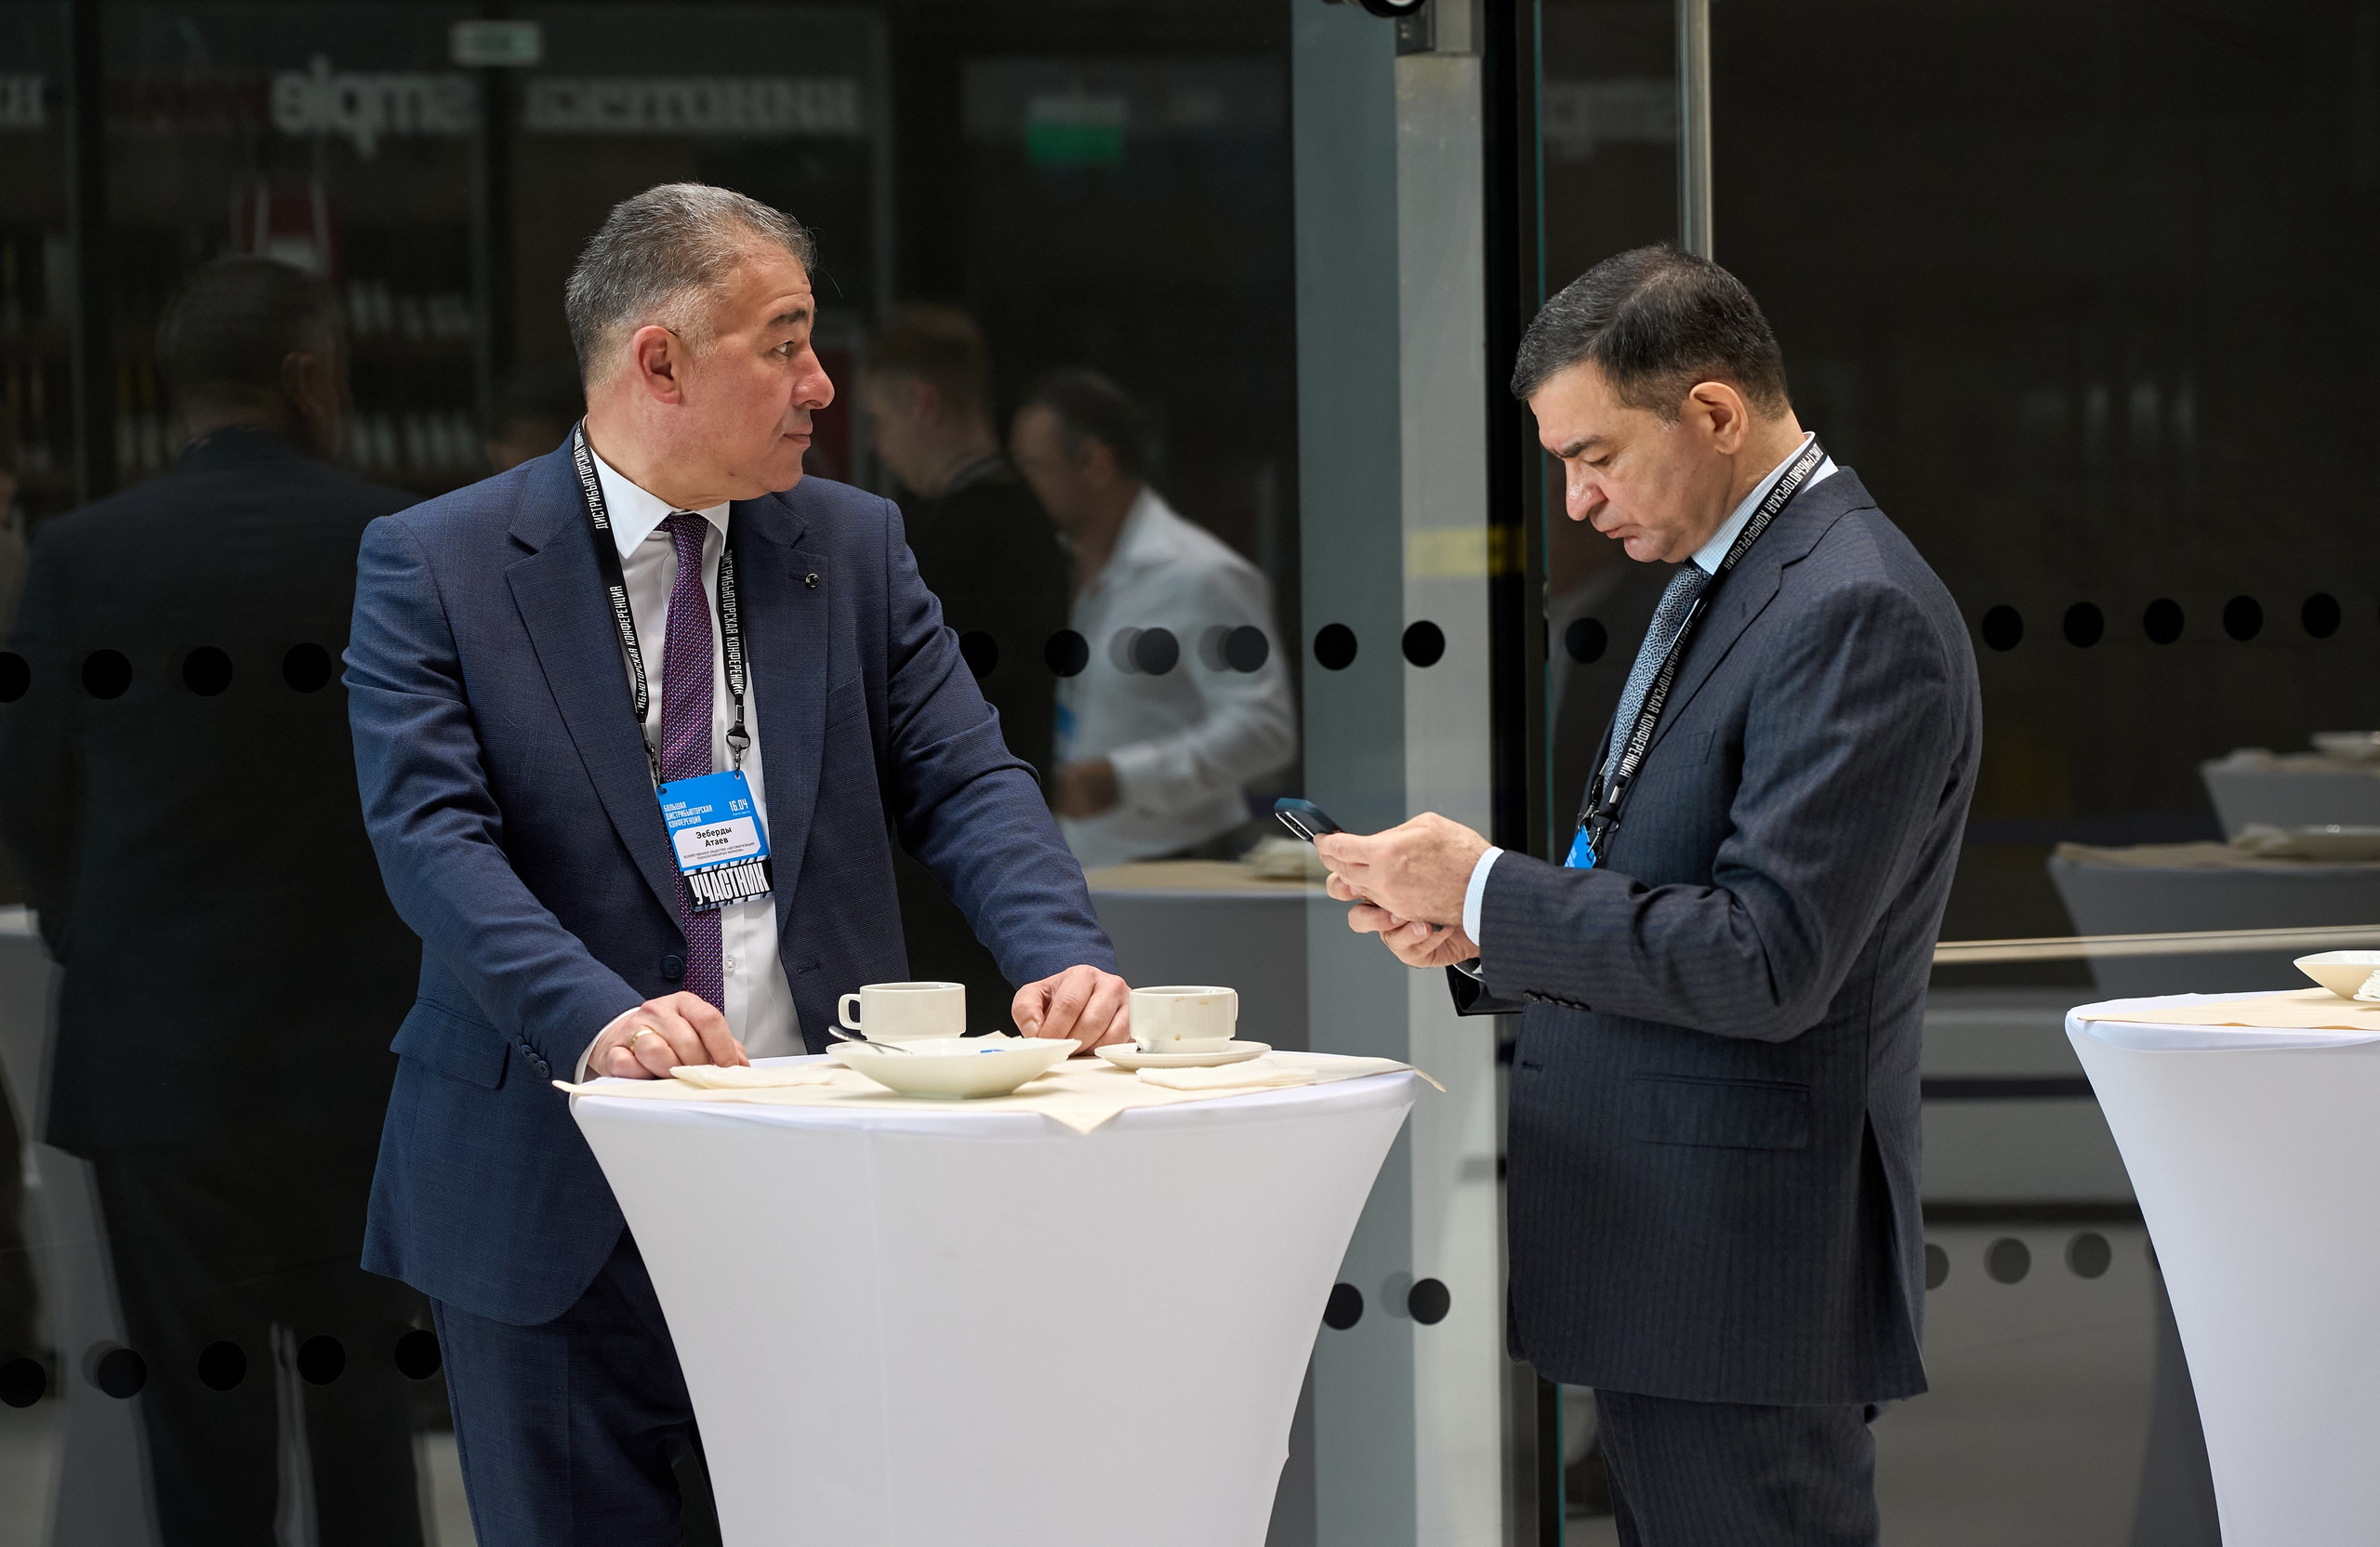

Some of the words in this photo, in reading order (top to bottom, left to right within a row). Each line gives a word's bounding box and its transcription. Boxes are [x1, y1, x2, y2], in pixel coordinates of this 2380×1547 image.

[575, 446, 609, 530] ДИСТРИБЬЮТОРСКАЯ
[1767, 442, 1825, 514] ДИСТРИБЬЮТОРСКАЯ
[1723, 507, 1773, 571] КОНФЕРЕНЦИЯ
[610, 585, 636, 646] КОНФЕРЕНЦИЯ
[721, 549, 738, 635] ДИСТРИБЬЮТОРСКАЯ
[628, 646, 647, 712] ИБЬЮТОРСКАЯ
[726, 636, 744, 694] КОНФЕРЕНЦИЯ
[1646, 620, 1694, 715] ДИСТРИБЬЮТОРСКАЯ
[1619, 709, 1658, 779] КОНФЕРЕНЦИЯ
[663, 801, 687, 813] БОЛЬШАЯ
[665, 804, 713, 821] ДИСТРИБЬЮТОРСКАЯ
[695, 826, 733, 840] Эеберды
[728, 799, 748, 813] 16.04
[705, 837, 729, 848] Атаев
[688, 862, 770, 906] УЧАСТНИК
